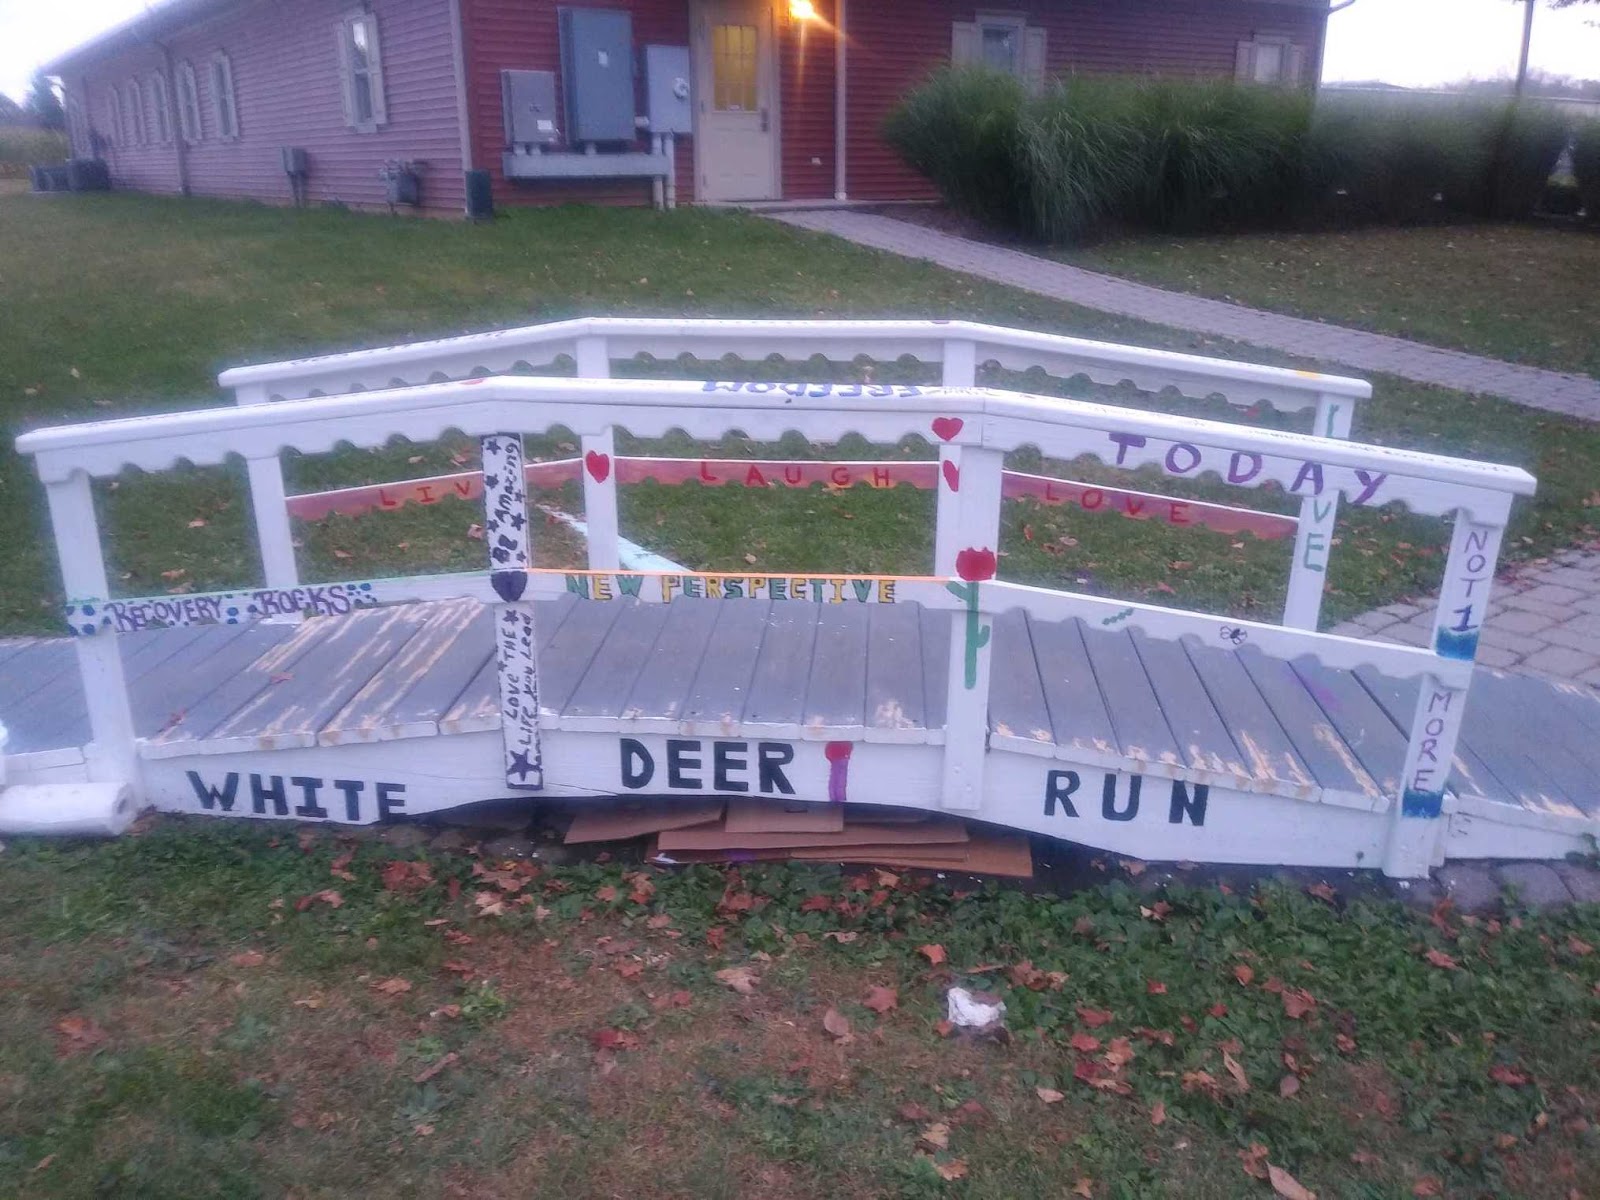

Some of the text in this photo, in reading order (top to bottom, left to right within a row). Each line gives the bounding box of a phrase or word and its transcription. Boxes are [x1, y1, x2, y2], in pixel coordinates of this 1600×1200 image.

[701, 380, 923, 397] FREEDOM
[378, 461, 1191, 524] LIV LAUGH LOVE
[1108, 431, 1387, 505] TODAY
[104, 585, 352, 634] RECOVERY ROCKS
[565, 574, 897, 604] NEW PERSPECTIVE
[1412, 530, 1489, 793] NOT 1 MORE
[185, 738, 1210, 827] WHITE DEER RUN
